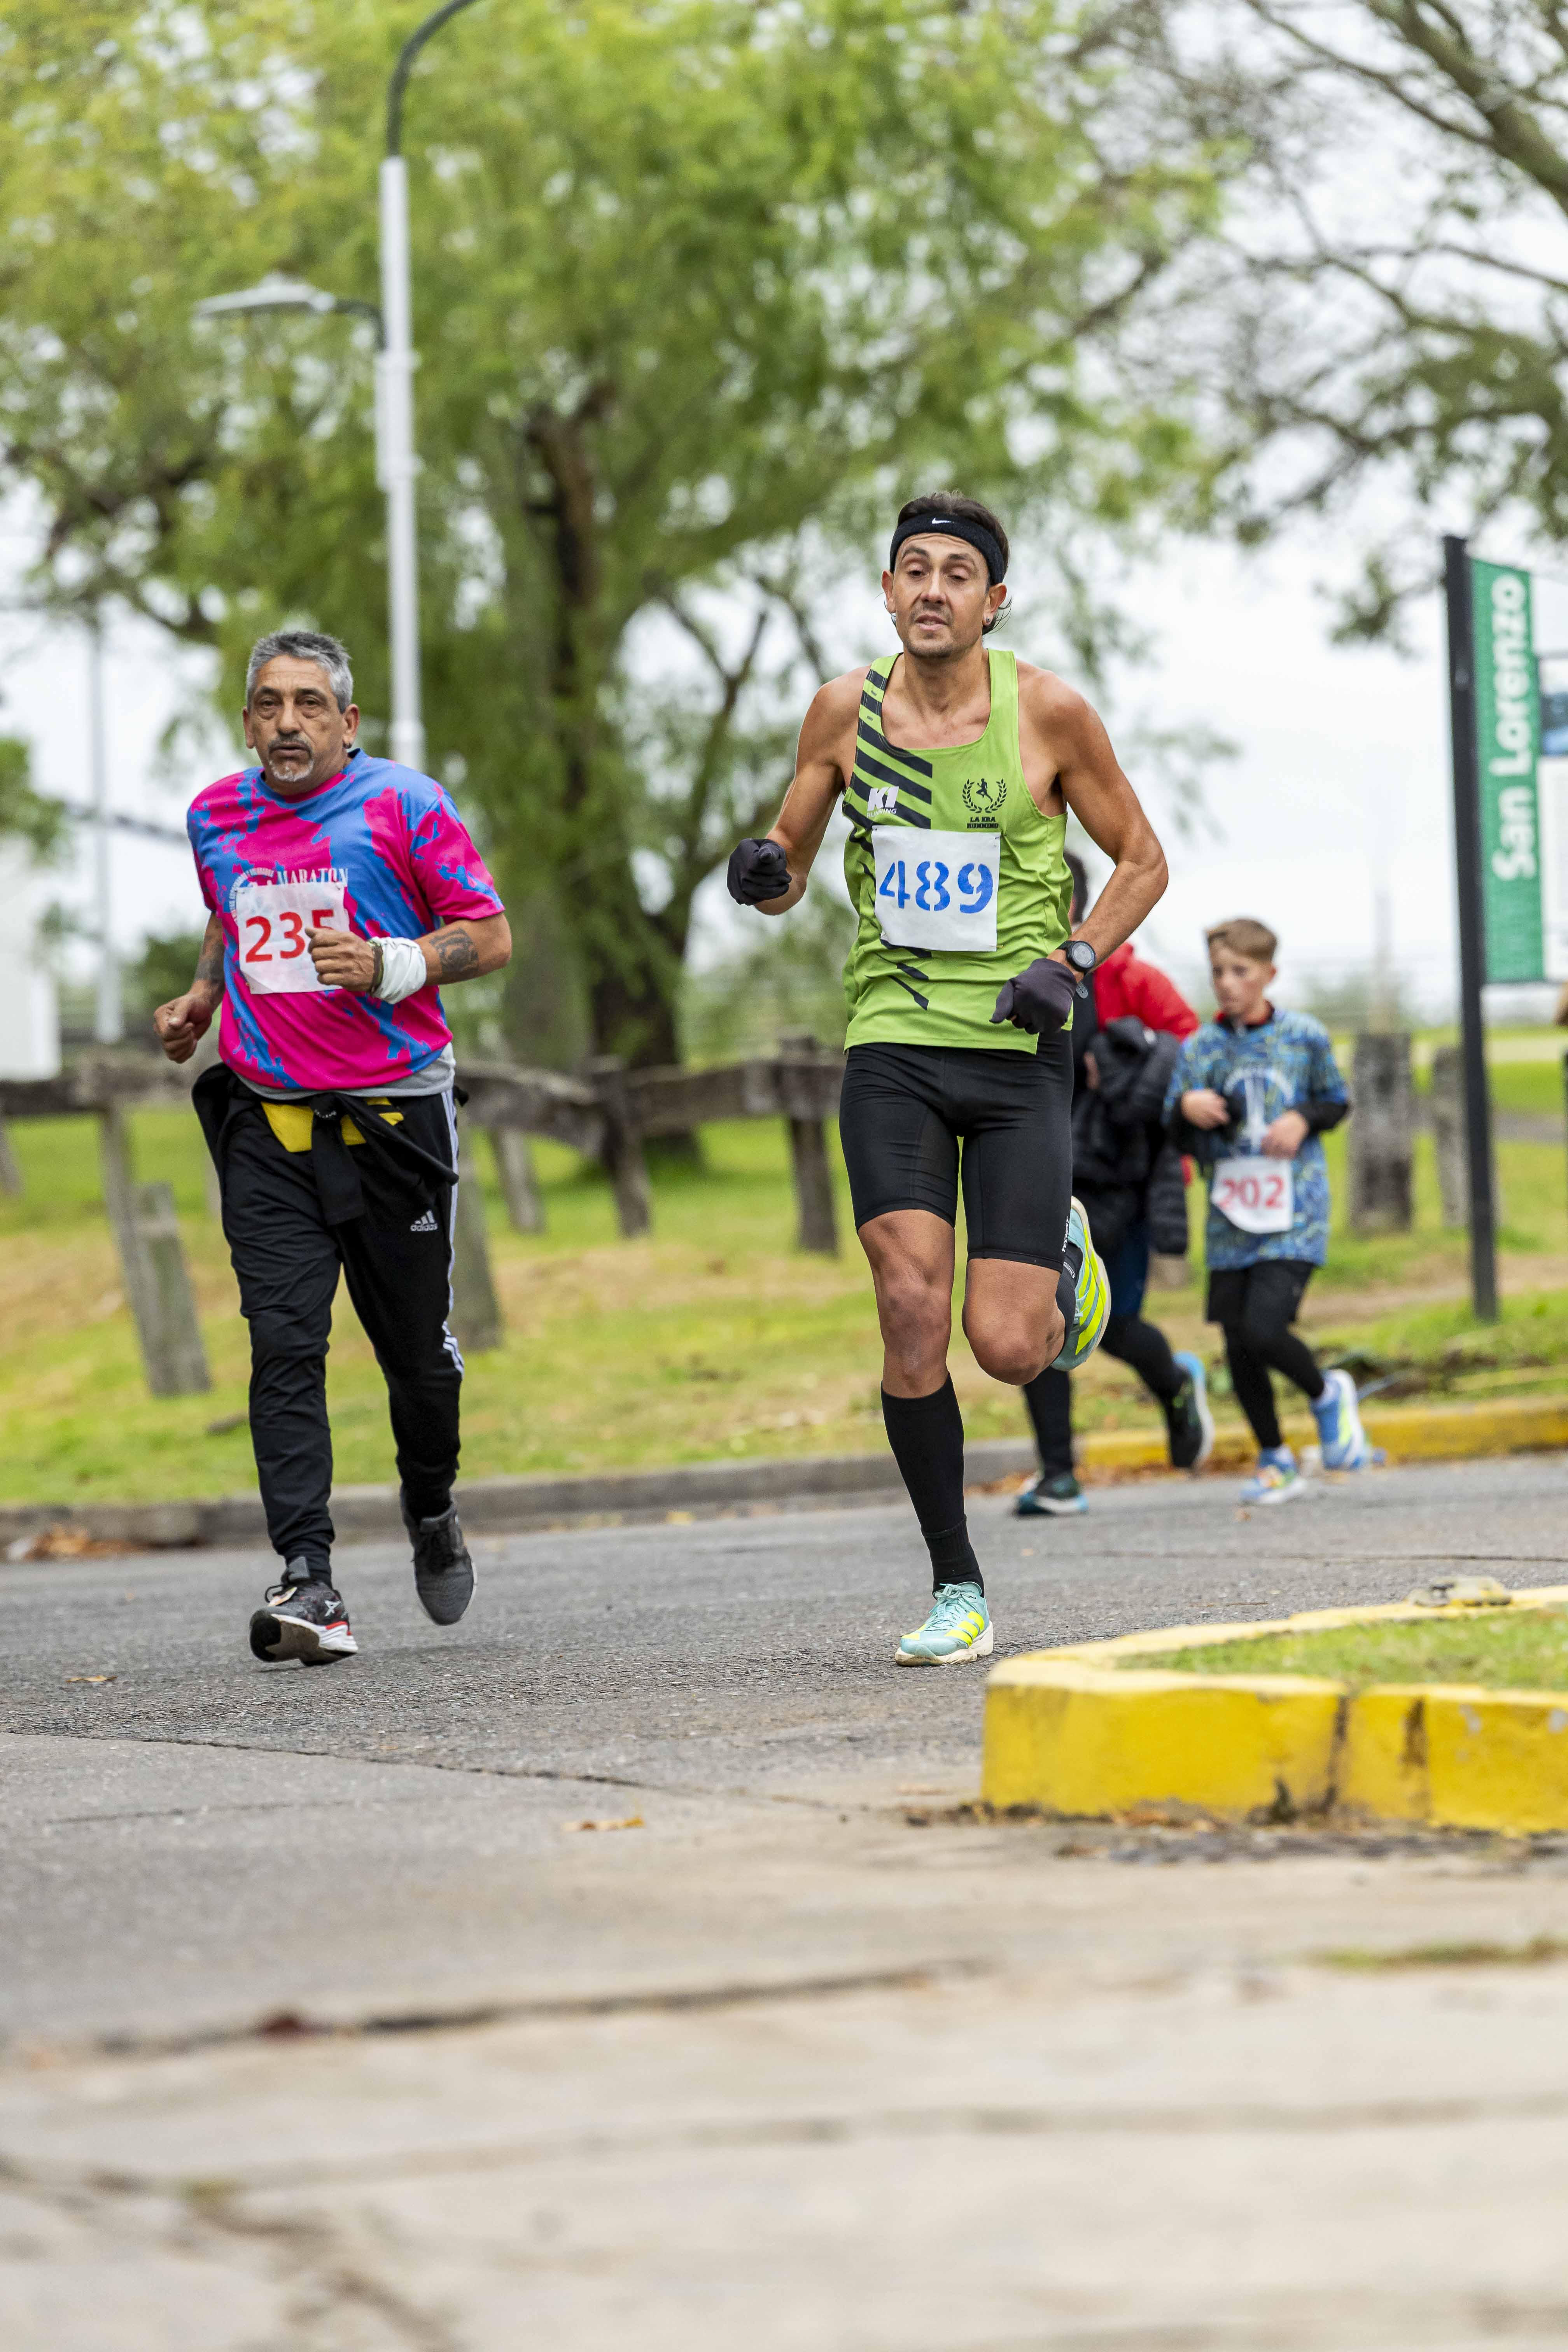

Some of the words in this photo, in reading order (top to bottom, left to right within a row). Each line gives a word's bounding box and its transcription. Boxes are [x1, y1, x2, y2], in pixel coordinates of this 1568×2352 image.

[1489, 574, 1531, 775] Lorenzo
[867, 786, 899, 812] K1
[867, 808, 897, 818] RUNNING
[1492, 786, 1537, 880] San
[879, 861, 993, 914] 489
[1220, 1175, 1284, 1210] 202
[411, 1223, 438, 1231] adidas
